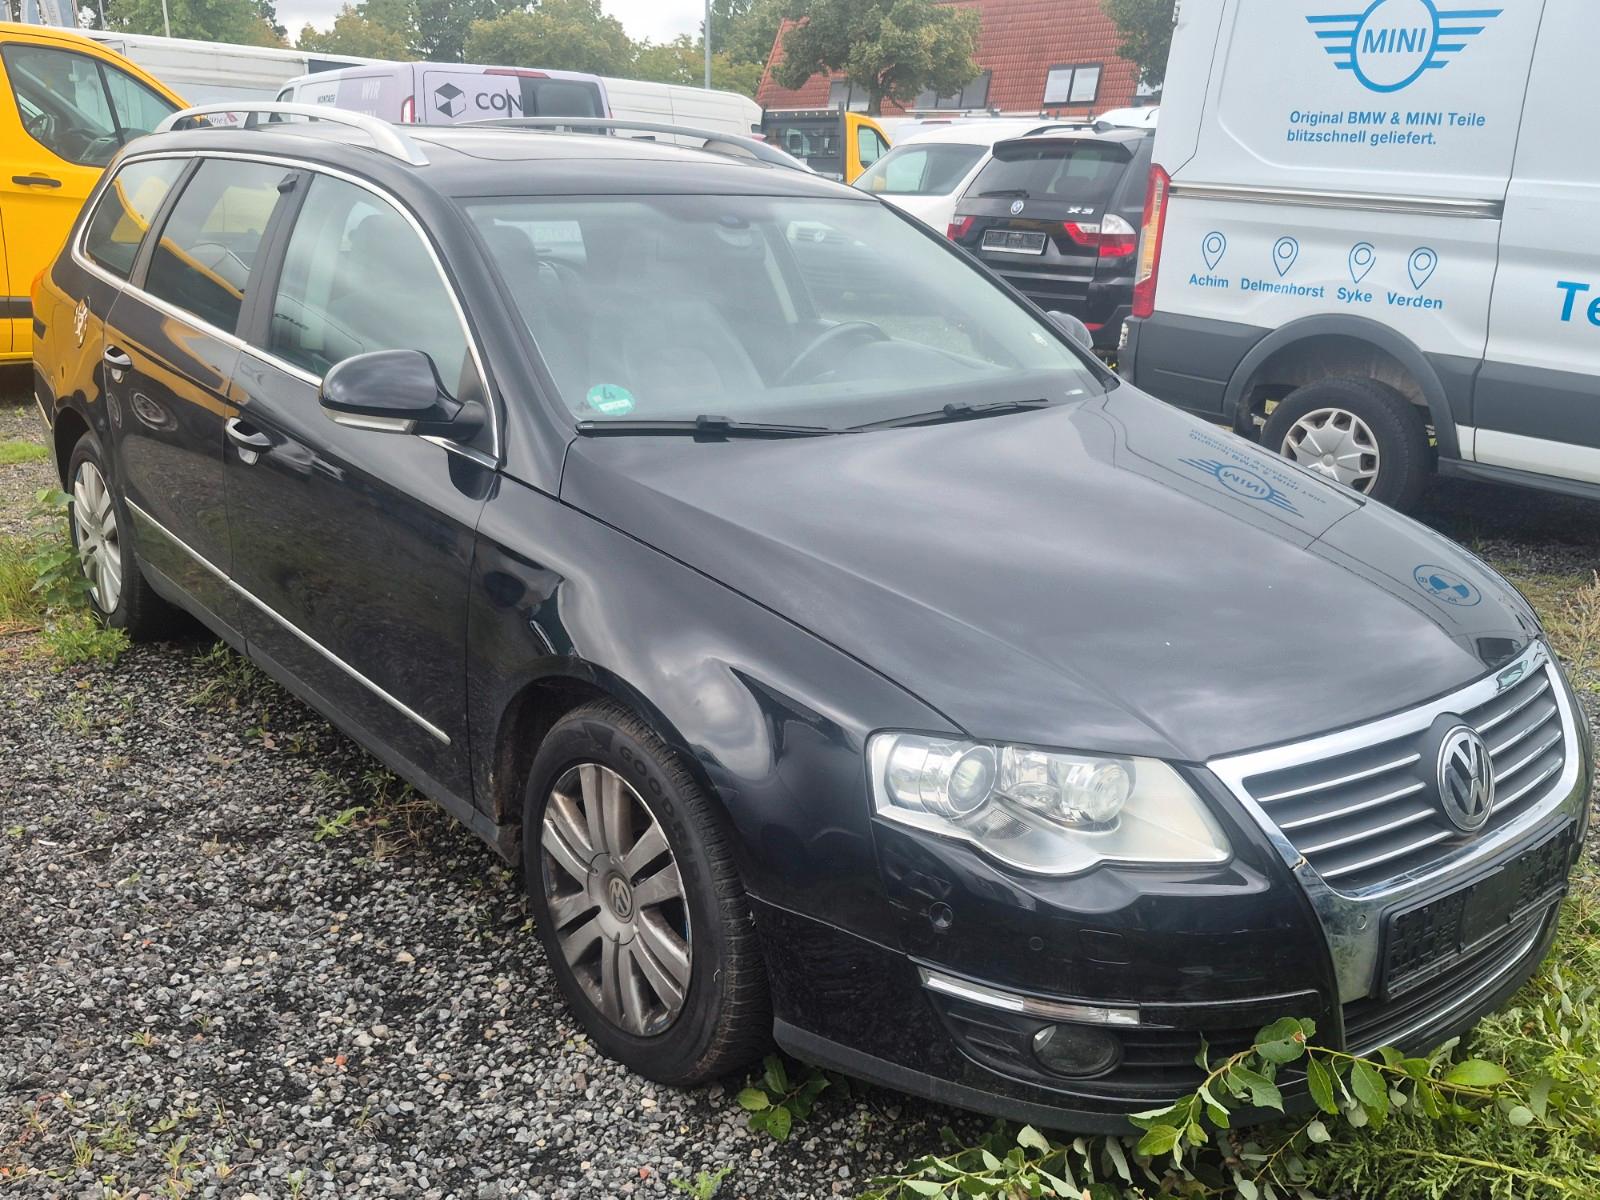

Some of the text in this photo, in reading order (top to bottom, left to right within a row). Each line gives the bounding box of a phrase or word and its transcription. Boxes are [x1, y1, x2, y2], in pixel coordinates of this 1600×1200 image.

[1362, 28, 1427, 53] MINI
[1290, 110, 1486, 127] Original BMW & MINI Teile
[1287, 129, 1437, 146] blitzschnell geliefert.
[1067, 206, 1094, 215] X3
[1189, 273, 1229, 289] Achim
[1240, 278, 1325, 298] Delmenhorst
[1337, 287, 1373, 303] Syke
[1387, 292, 1443, 310] Verden
